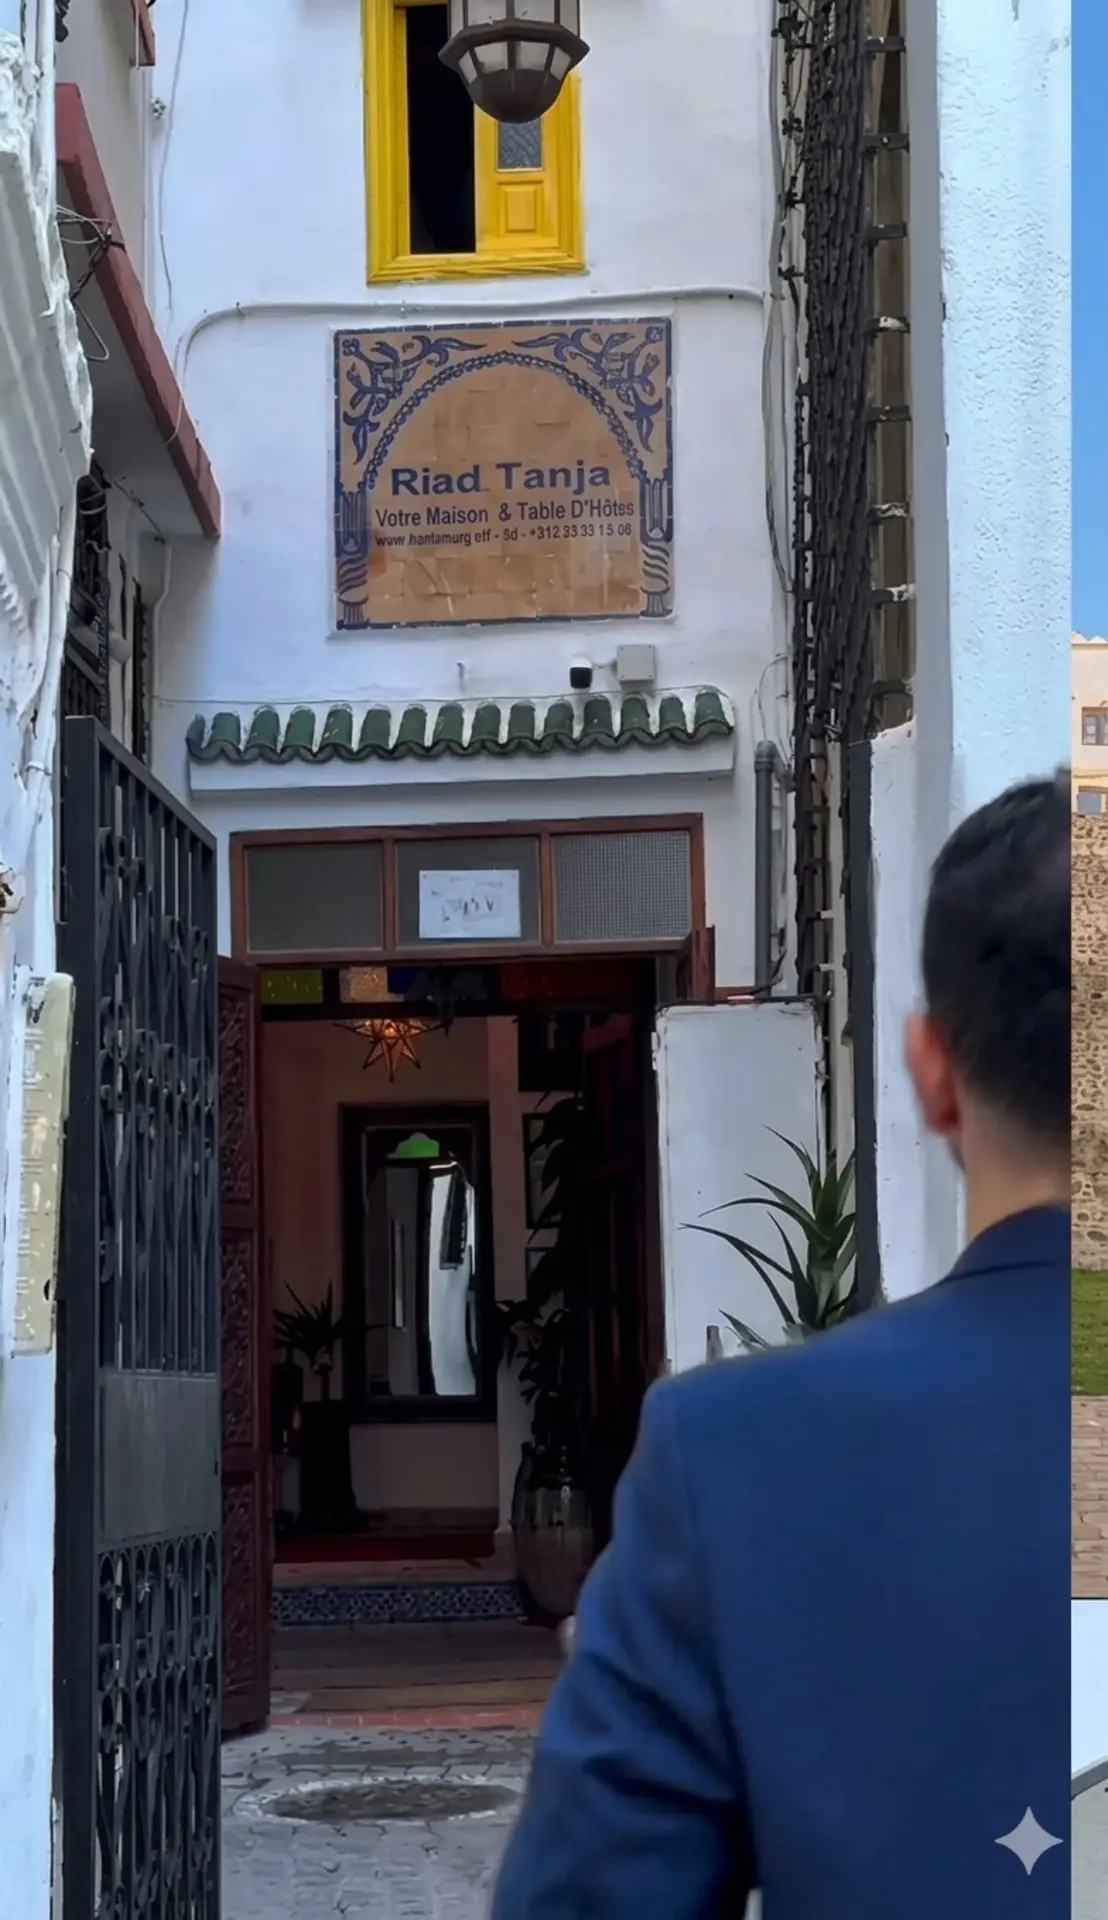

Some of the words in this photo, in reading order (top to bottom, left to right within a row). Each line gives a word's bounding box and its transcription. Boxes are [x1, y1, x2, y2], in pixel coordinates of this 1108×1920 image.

[391, 464, 481, 496] Riad
[496, 460, 610, 496] Tanja
[375, 509, 421, 527] Votre
[426, 506, 489, 525] Maison
[498, 502, 512, 522] &
[516, 501, 566, 521] Table
[580, 523, 595, 537] 33
